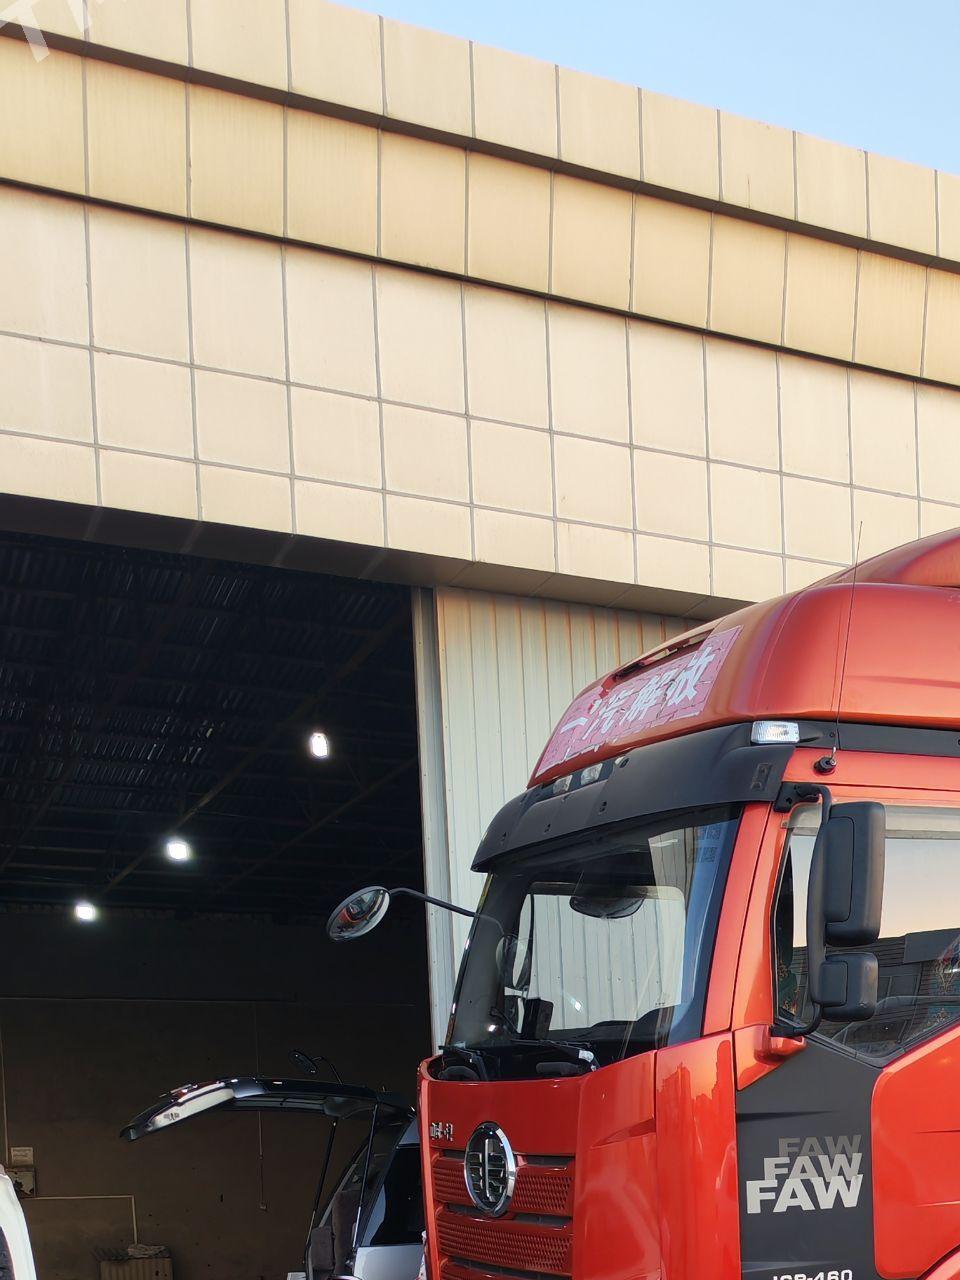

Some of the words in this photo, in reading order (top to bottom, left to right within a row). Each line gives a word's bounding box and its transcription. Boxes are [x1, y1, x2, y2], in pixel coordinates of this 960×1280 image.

[560, 646, 716, 741] 一汽解放
[778, 1135, 862, 1158] FAW
[763, 1153, 862, 1183] FAW
[746, 1174, 864, 1214] FAW
